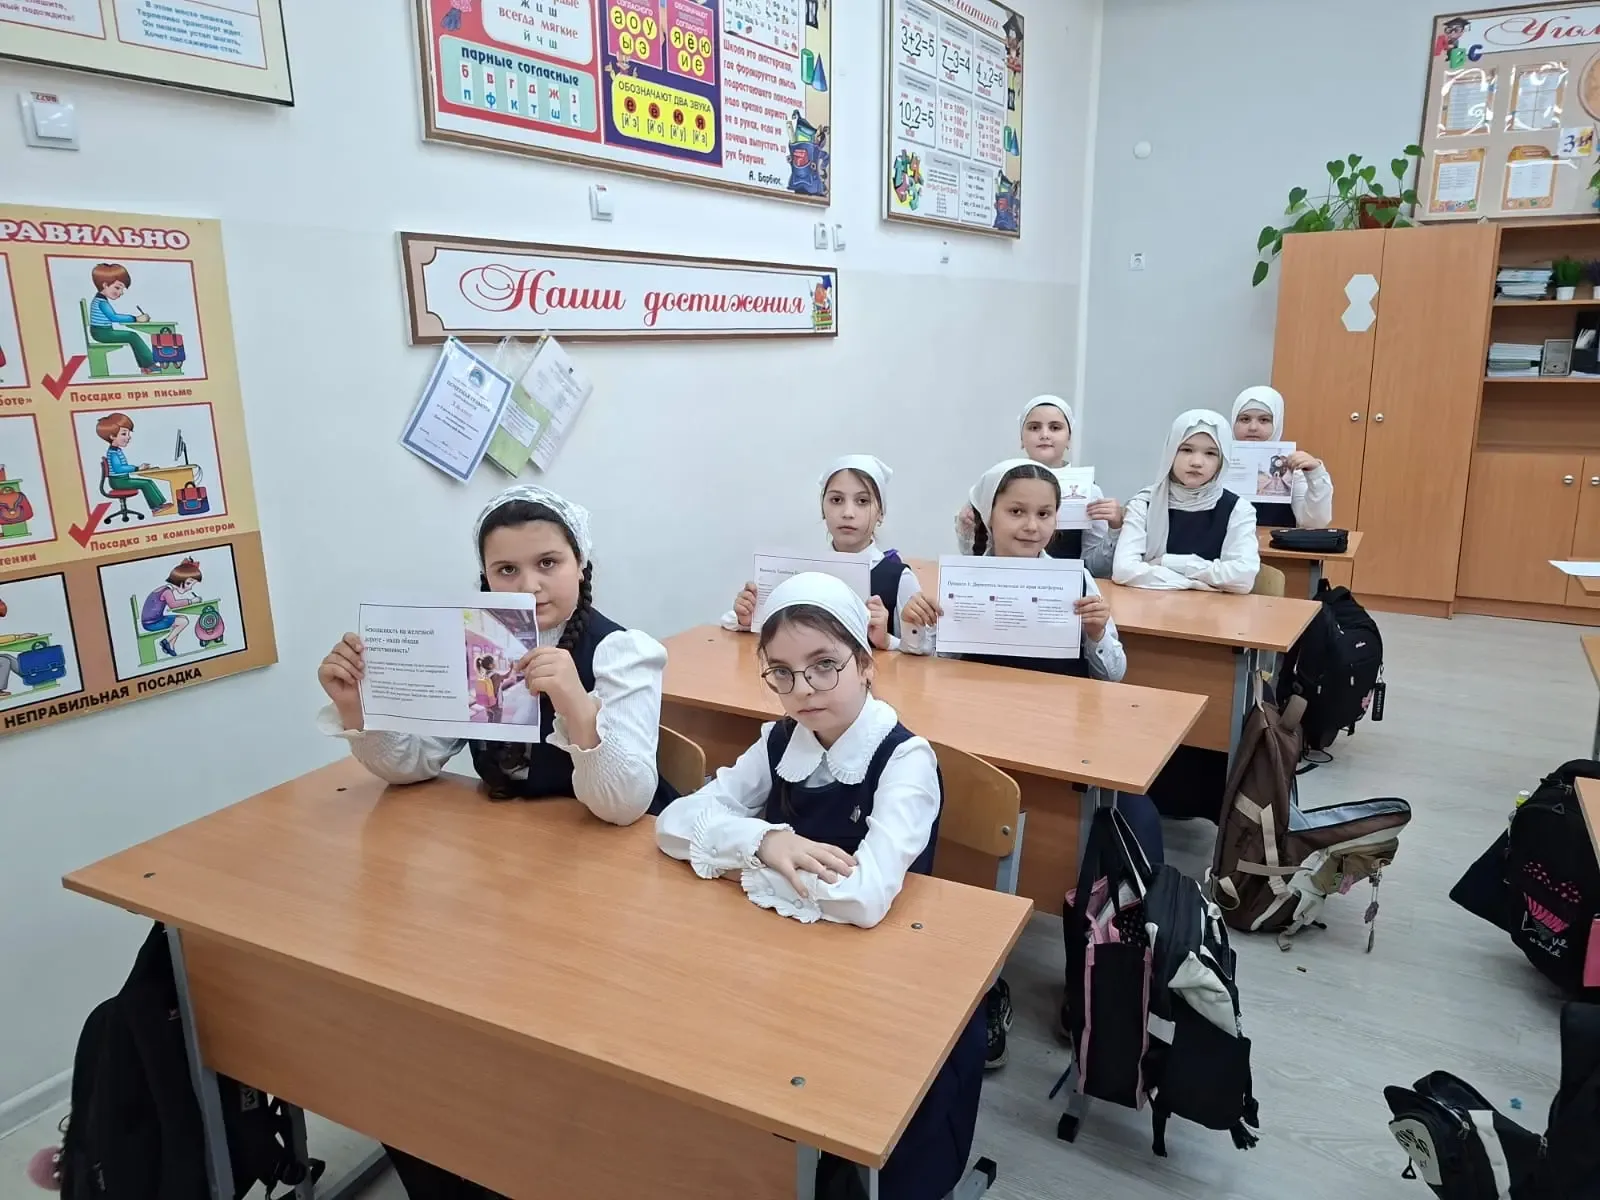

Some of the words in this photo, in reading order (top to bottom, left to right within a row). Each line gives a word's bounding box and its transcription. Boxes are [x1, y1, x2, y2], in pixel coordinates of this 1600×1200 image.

[498, 8, 534, 26] всегда
[541, 20, 578, 39] мягкие
[462, 46, 513, 70] парные
[518, 61, 580, 86] согласные
[618, 80, 672, 102] ОБОЗНАЧАЮТ
[674, 96, 688, 108] ДВА
[690, 100, 711, 112] ЗВУКА
[0, 220, 190, 250] РАВИЛЬНО
[459, 264, 626, 315] Наши
[643, 290, 806, 328] достижения
[70, 391, 122, 402] Посадка
[127, 390, 148, 401] при
[154, 388, 192, 398] письме
[90, 536, 140, 552] Посадка
[146, 533, 158, 543] за
[163, 521, 236, 540] компьютером
[4, 686, 130, 728] НЕПРАВИЛЬНАЯ
[137, 667, 202, 694] ПОСАДКА
